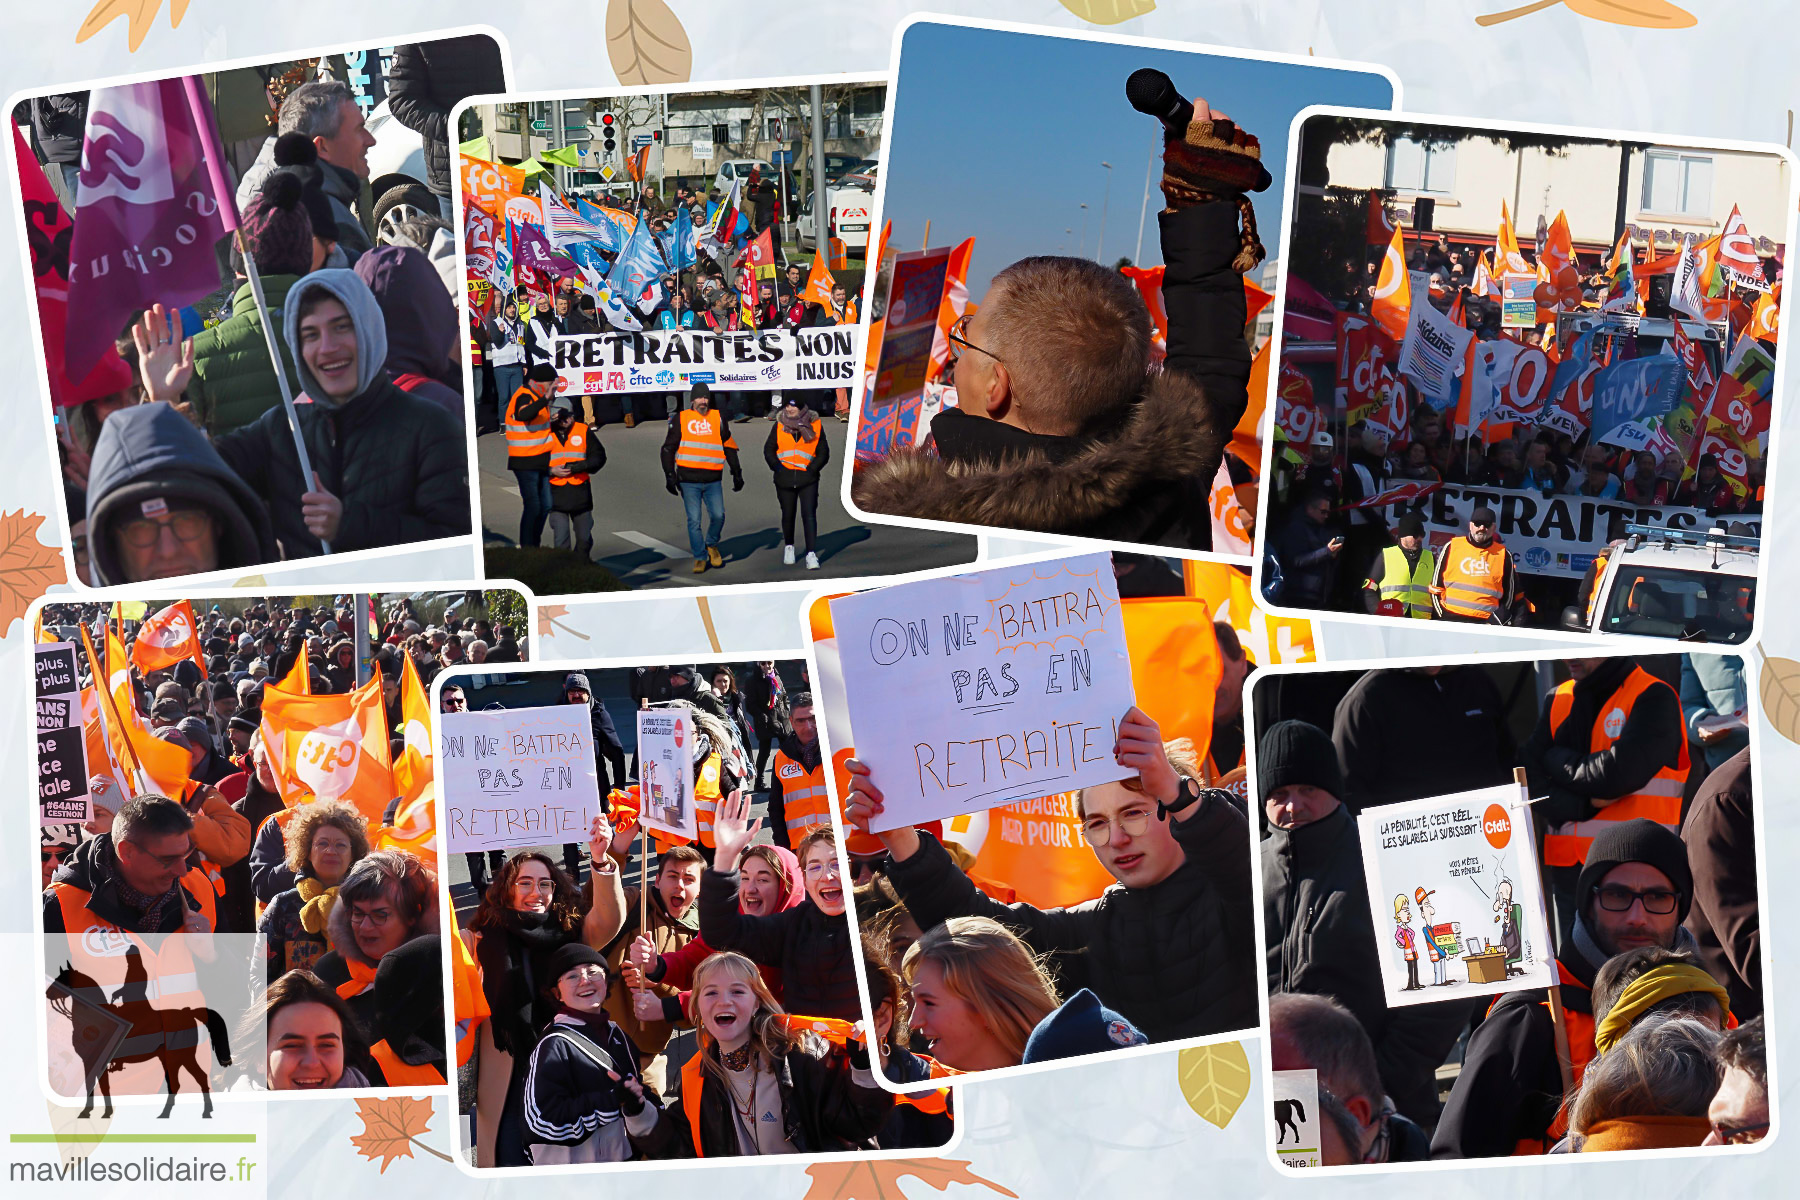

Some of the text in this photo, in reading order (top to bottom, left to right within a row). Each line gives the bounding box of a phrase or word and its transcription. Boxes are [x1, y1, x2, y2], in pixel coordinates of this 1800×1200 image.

[555, 330, 784, 370] RETRAITES
[795, 331, 853, 357] NON
[629, 374, 653, 386] cftc
[719, 373, 757, 382] Solidaires
[761, 365, 775, 376] CFE
[796, 361, 857, 381] INJUS
[687, 419, 712, 435] Cfdt
[1616, 424, 1647, 441] fsu
[1460, 556, 1491, 576] Cfdt
[870, 588, 1104, 666] ON NE BATTRA
[35, 658, 68, 675] plus,
[951, 648, 1092, 704] PAS EN
[42, 673, 71, 690] plus
[474, 734, 499, 760] NE
[512, 733, 582, 756] BATTRA
[477, 766, 572, 791] PAS EN
[46, 801, 85, 811] #64ANS
[47, 810, 83, 818] CESTNON
[1380, 821, 1390, 836] LA
[1430, 812, 1451, 827] C'EST
[1452, 808, 1472, 823] RÉEL
[1484, 818, 1511, 835] Cfdt:
[1028, 820, 1073, 848] POUR
[1382, 836, 1398, 850] LES
[1398, 830, 1429, 847] SALARIÉS
[1429, 829, 1439, 841] LA
